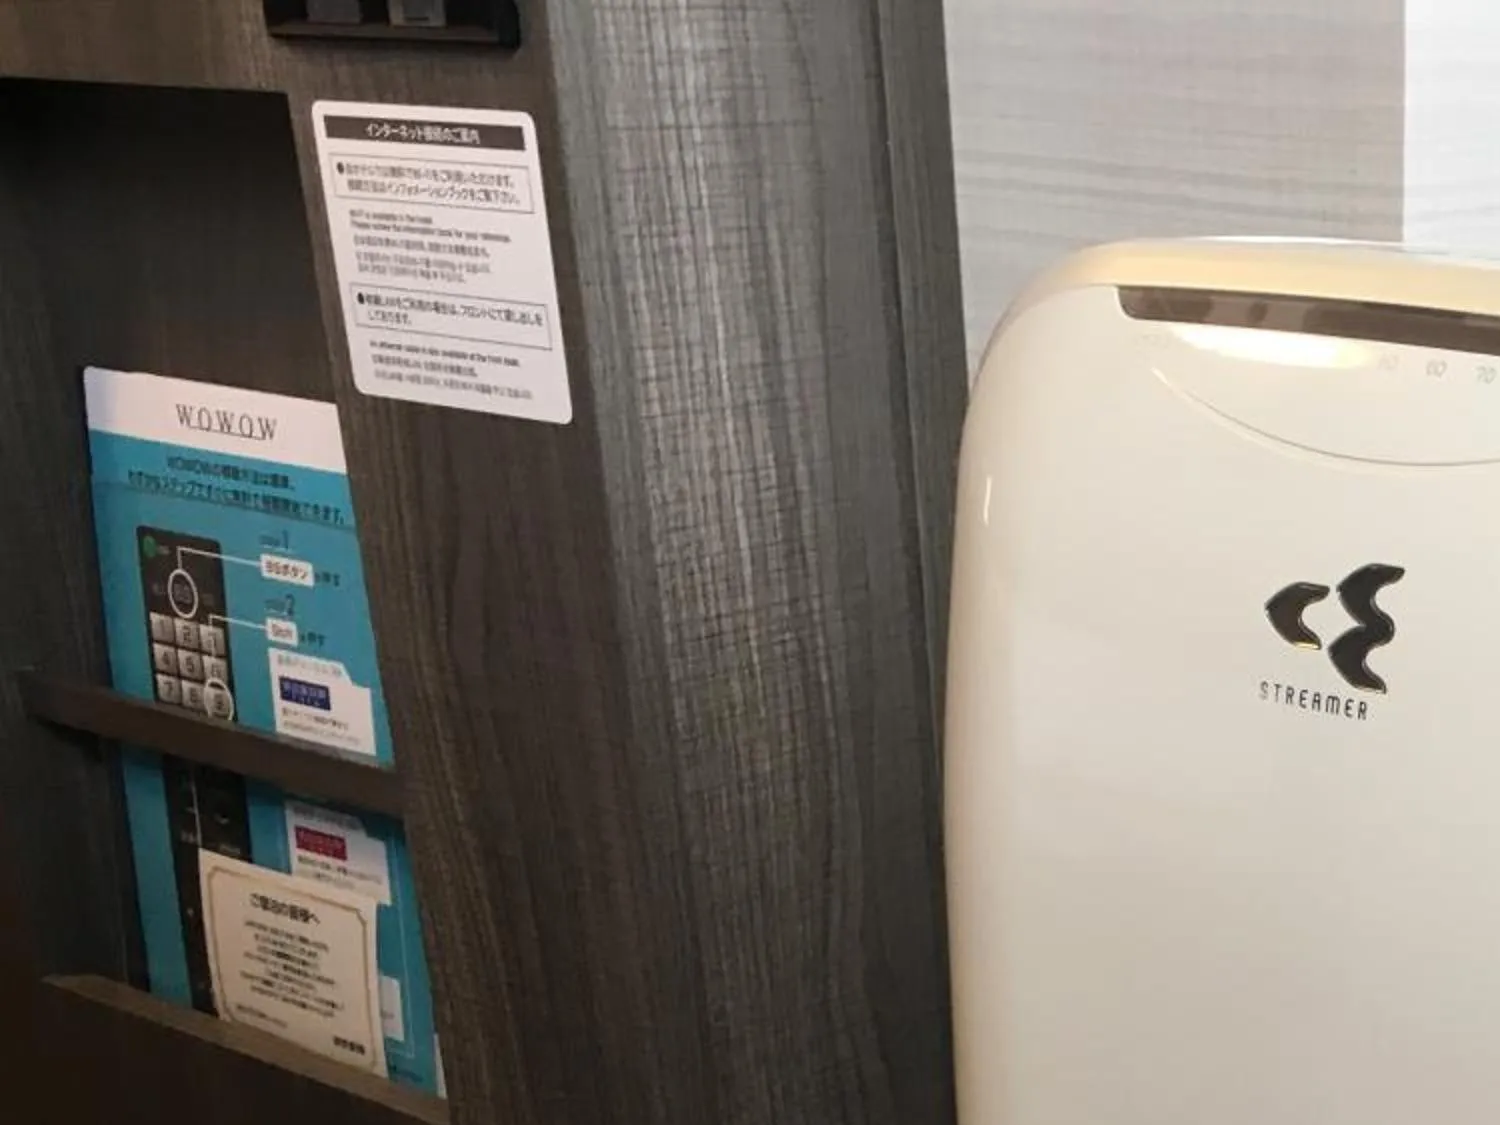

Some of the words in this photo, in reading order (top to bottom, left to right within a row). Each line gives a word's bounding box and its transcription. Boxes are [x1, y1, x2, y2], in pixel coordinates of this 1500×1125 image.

[1475, 365, 1498, 384] 70
[175, 403, 278, 441] WOWOW
[1259, 681, 1369, 720] STREAMER
